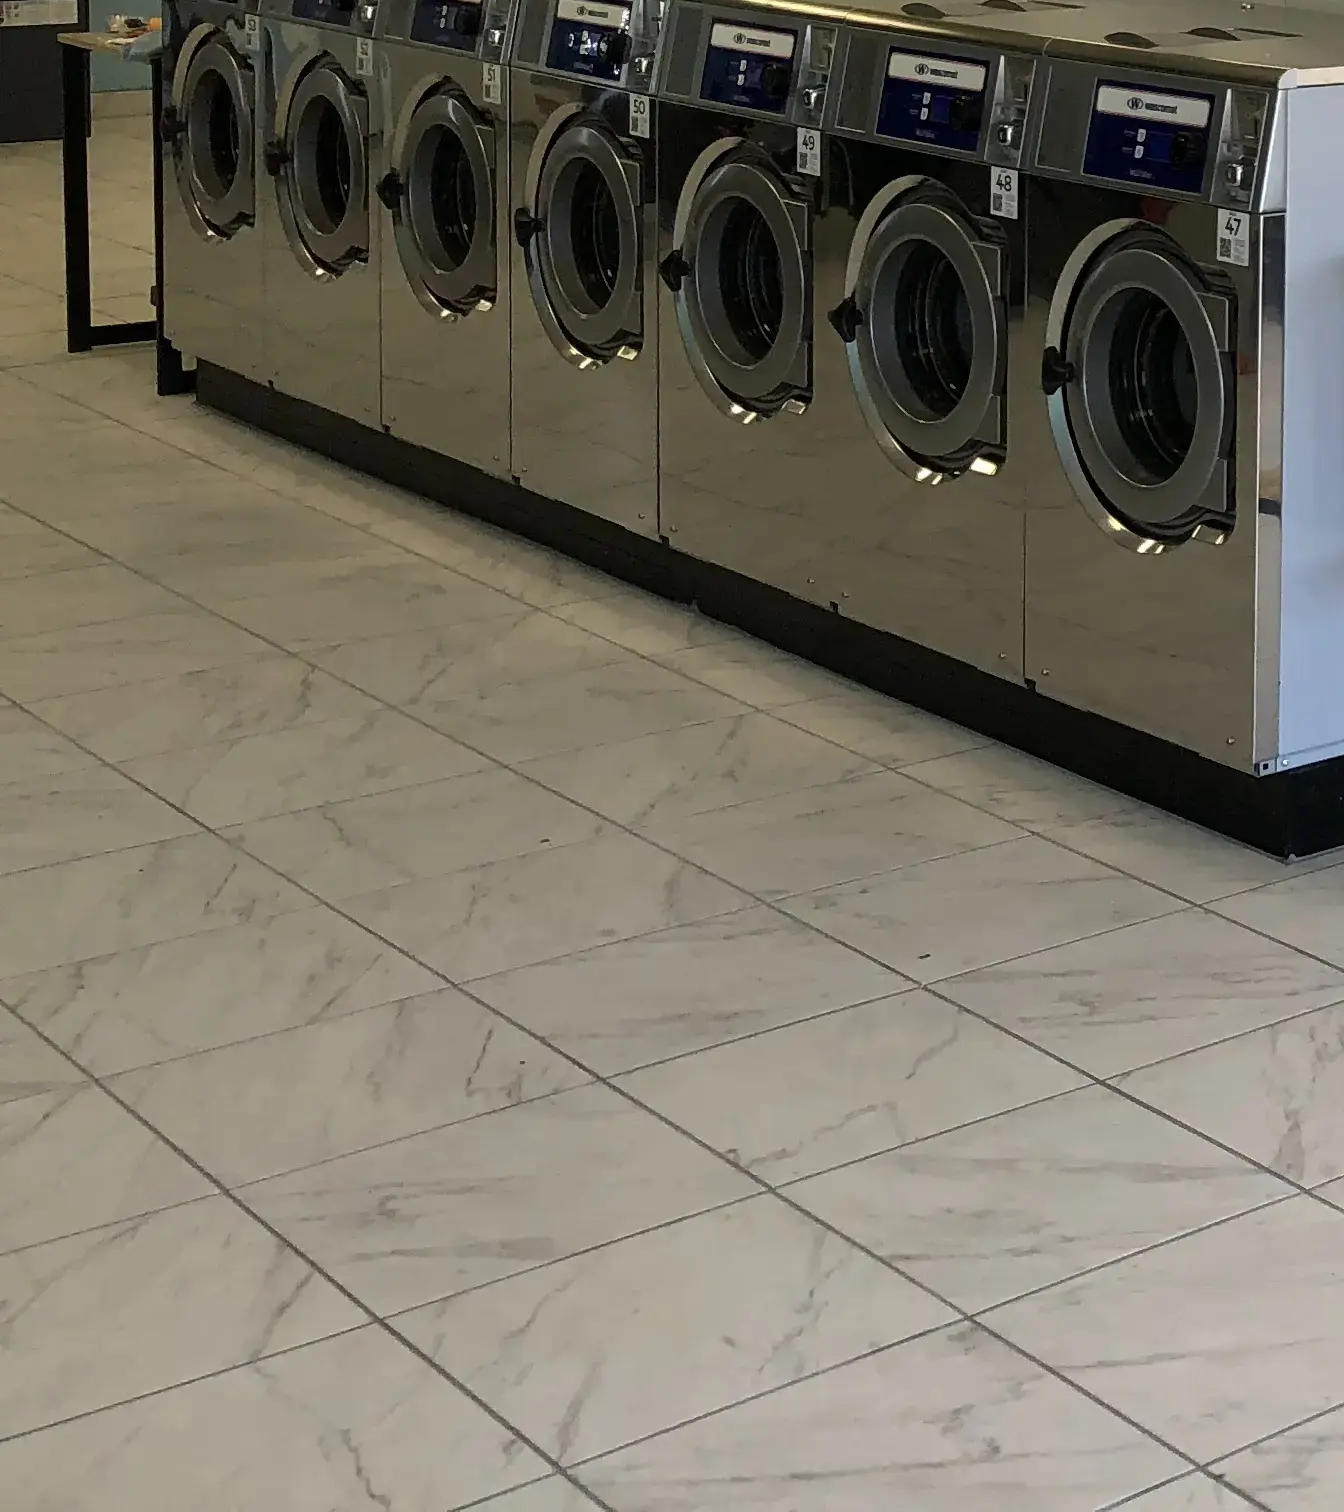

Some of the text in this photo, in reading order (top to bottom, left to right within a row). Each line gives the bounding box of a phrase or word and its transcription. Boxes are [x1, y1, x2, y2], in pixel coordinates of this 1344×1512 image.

[633, 99, 646, 115] 50
[802, 135, 815, 151] 49
[996, 173, 1012, 192] 48
[1225, 216, 1242, 236] 47
